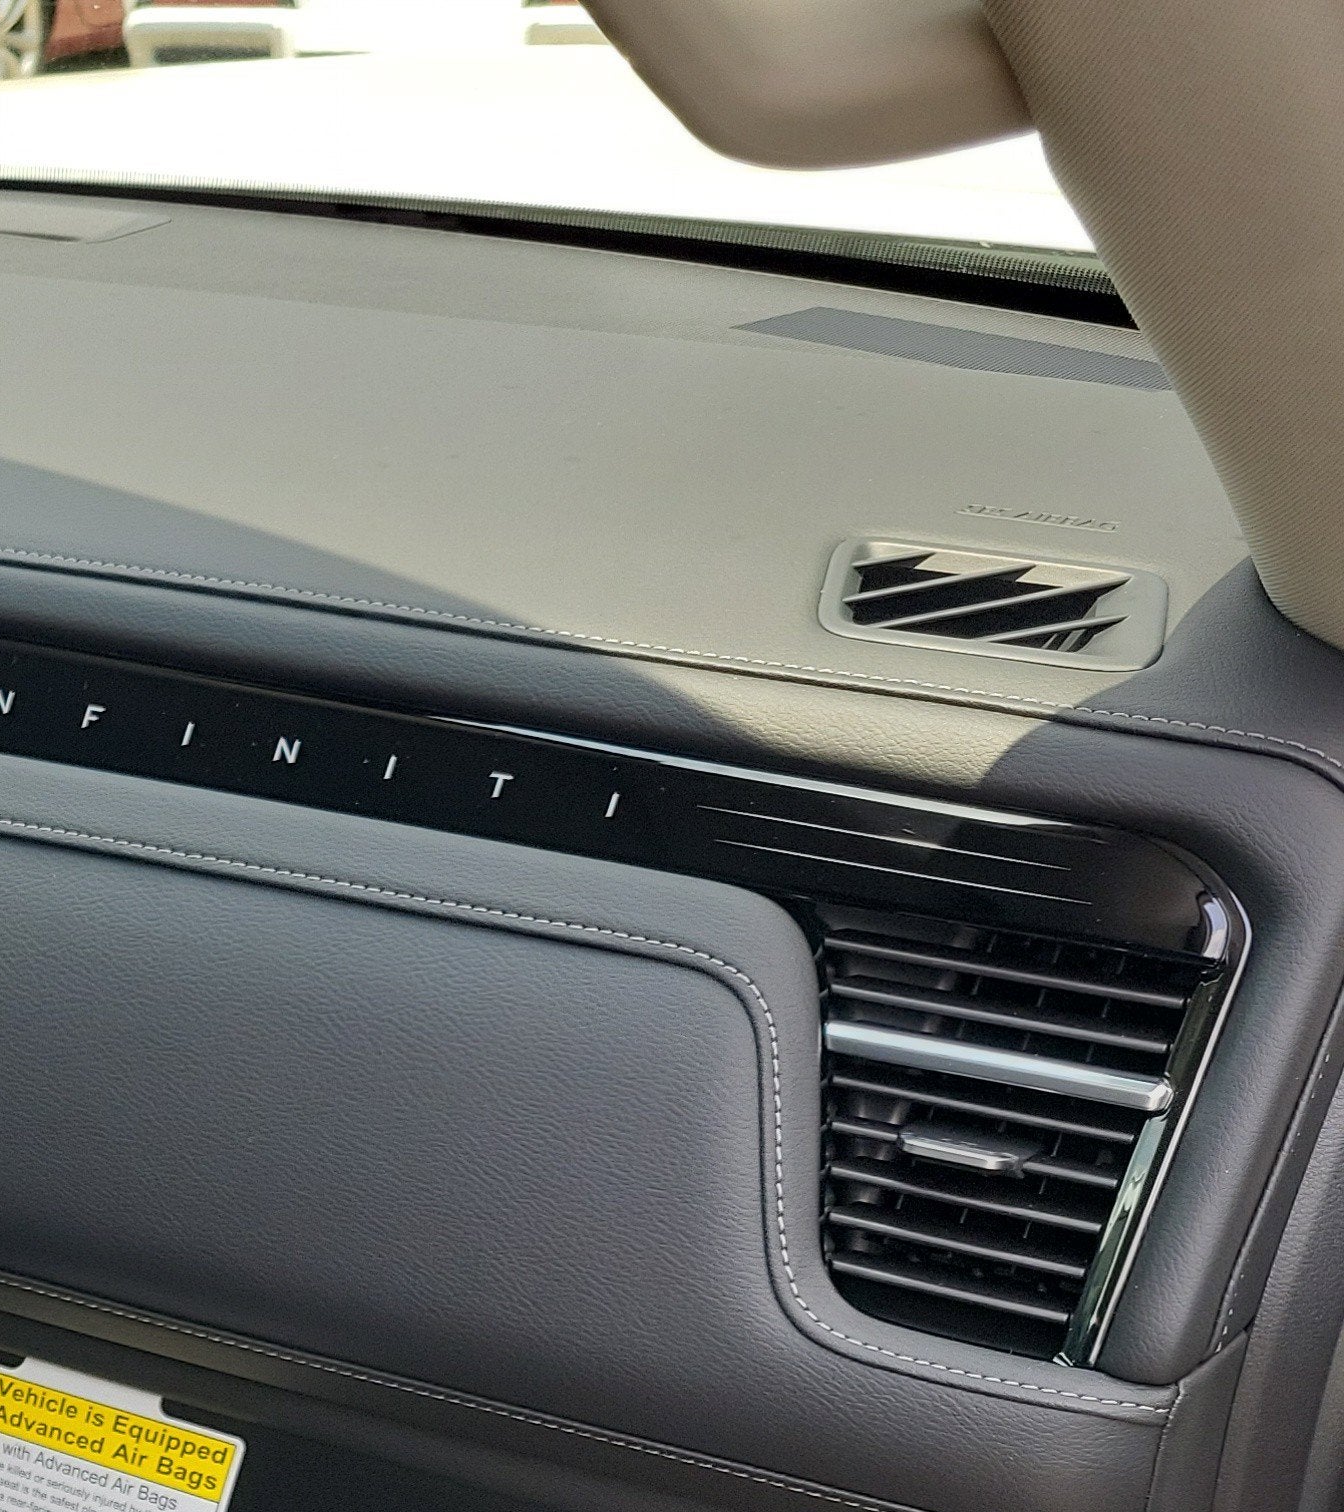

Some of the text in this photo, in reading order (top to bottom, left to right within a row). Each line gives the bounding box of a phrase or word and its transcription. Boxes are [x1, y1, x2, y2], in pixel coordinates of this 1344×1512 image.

[85, 1405, 105, 1428] is
[112, 1413, 228, 1466] Equipped
[1, 1442, 32, 1462] with
[34, 1451, 109, 1488] Advanced
[111, 1476, 134, 1496] Air
[138, 1485, 178, 1511] Bags
[112, 1442, 148, 1468] Air
[156, 1456, 218, 1491] Bags
